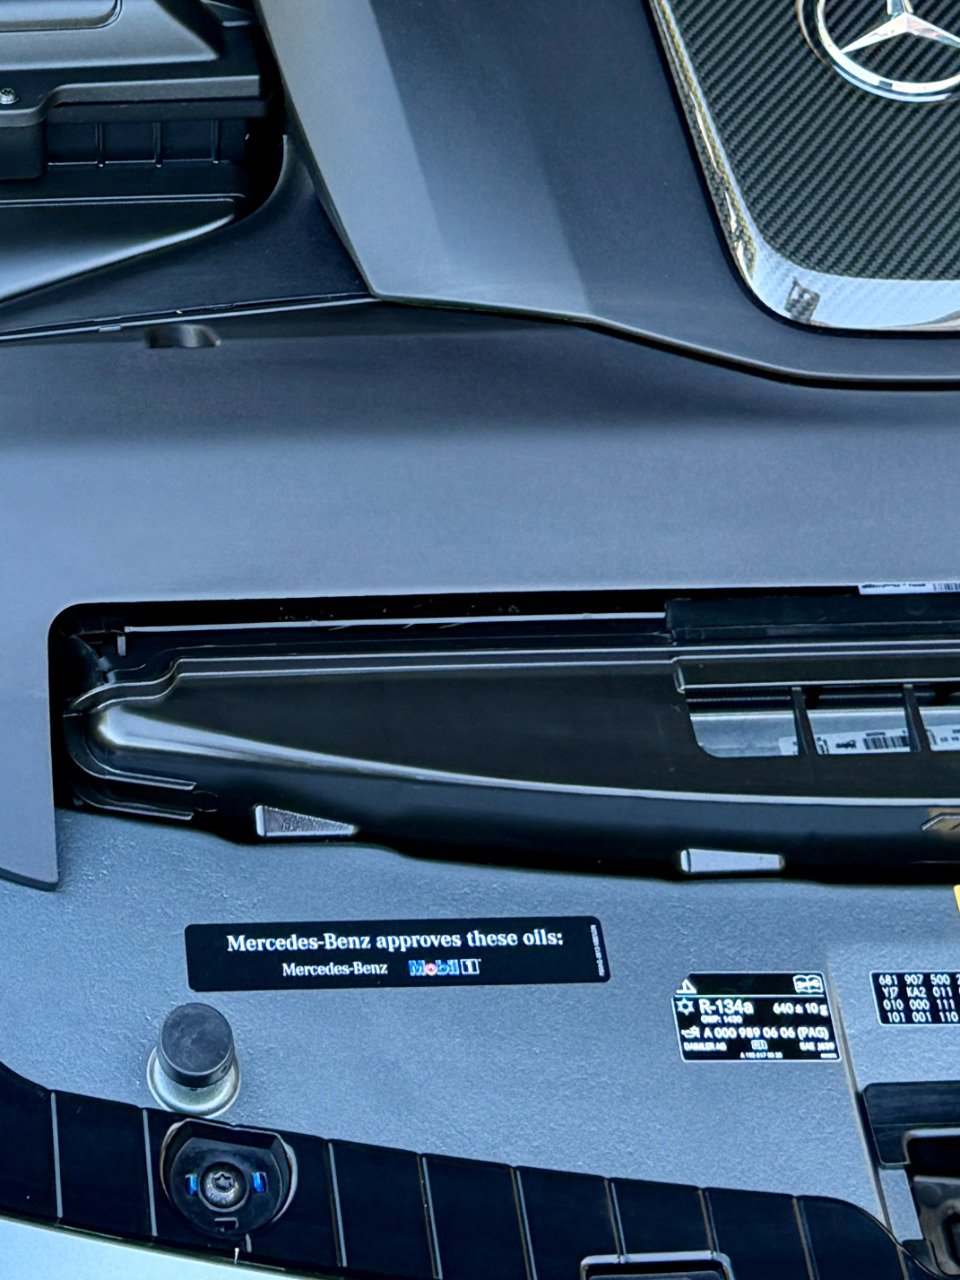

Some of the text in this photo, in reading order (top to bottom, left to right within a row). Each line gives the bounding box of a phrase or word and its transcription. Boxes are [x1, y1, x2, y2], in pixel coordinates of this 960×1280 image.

[226, 928, 564, 952] Mercedes-Benz approves these oils:
[282, 962, 388, 976] Mercedes-Benz
[408, 959, 460, 977] Mobil
[879, 974, 898, 986] 681
[904, 973, 924, 985] 907
[930, 973, 951, 985] 500
[906, 986, 927, 998] KA2
[932, 986, 953, 997] 011
[699, 999, 754, 1015] R-134a
[773, 1002, 794, 1015] 640
[883, 999, 955, 1011] 010 000 111
[887, 1011, 959, 1023] 101 001 110
[704, 1027, 829, 1040] A 000 989 06 06 (PAG)
